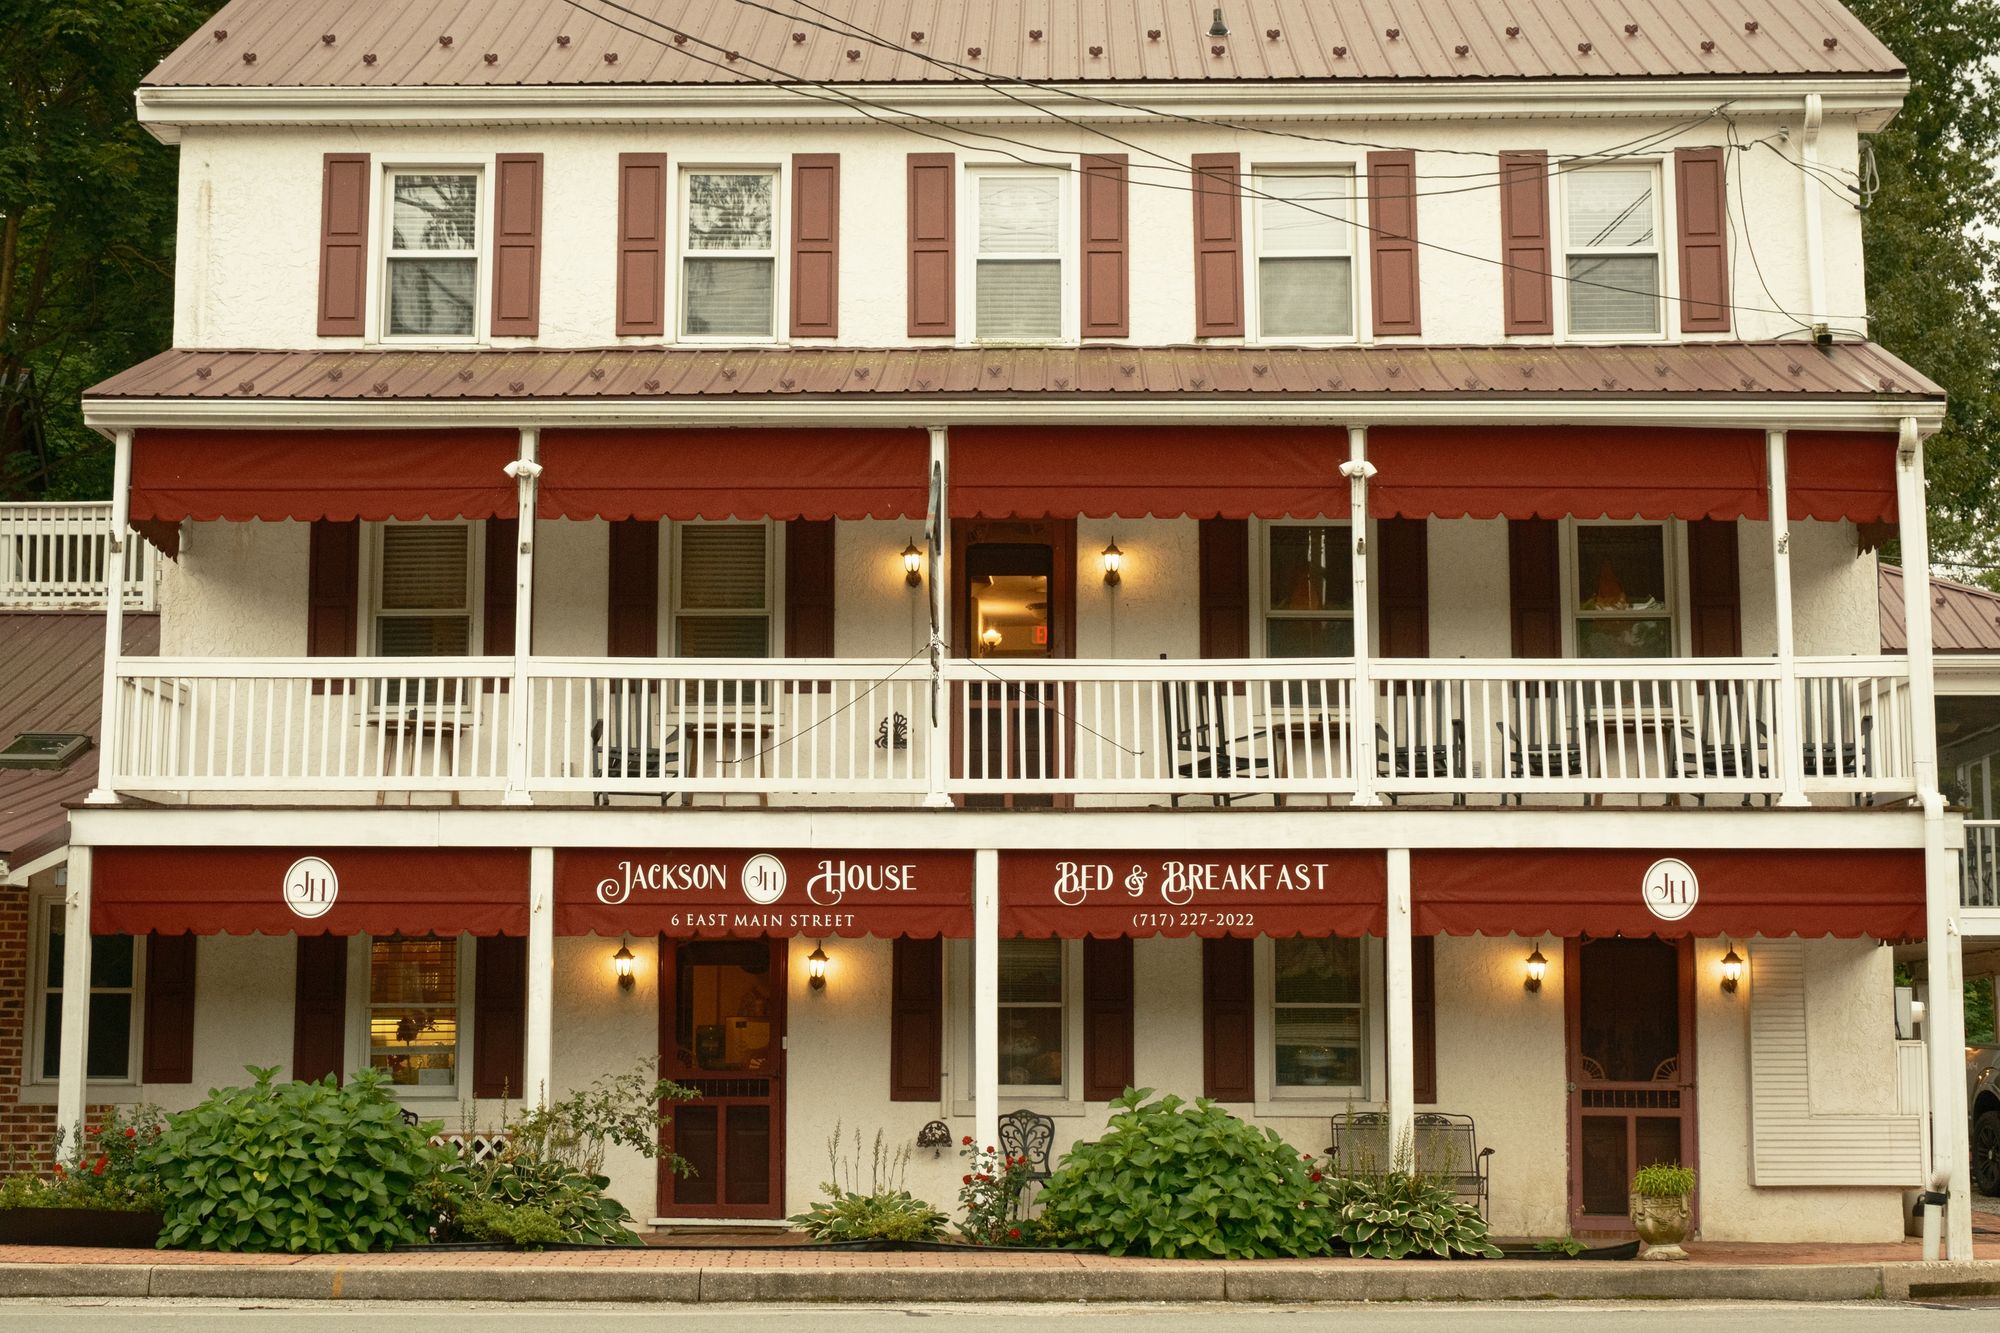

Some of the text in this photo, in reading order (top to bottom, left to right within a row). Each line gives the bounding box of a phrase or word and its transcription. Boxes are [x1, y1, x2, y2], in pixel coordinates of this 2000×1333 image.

[596, 860, 917, 906] JACKSON HOUSE
[1053, 861, 1329, 906] BED & BREAKFAST
[671, 913, 855, 928] 6 EAST MAIN STREET
[1132, 912, 1254, 928] (717) 227-2022
